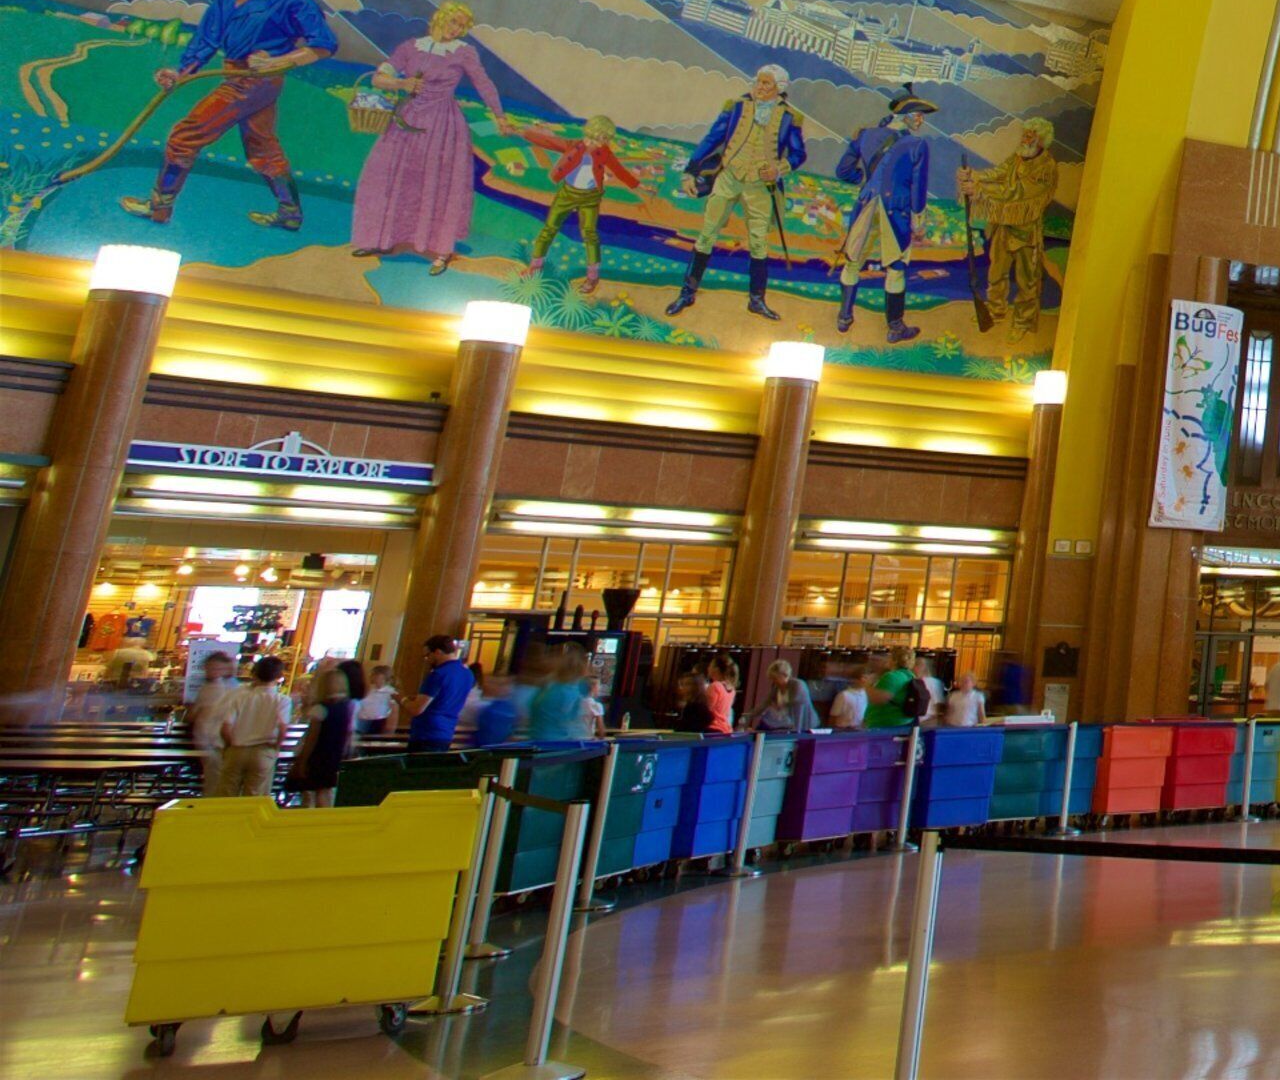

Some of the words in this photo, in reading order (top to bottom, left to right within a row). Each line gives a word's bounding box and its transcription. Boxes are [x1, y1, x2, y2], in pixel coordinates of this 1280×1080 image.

[177, 447, 249, 468] STORE
[260, 454, 291, 471] TO
[301, 458, 391, 479] EXPLORE
